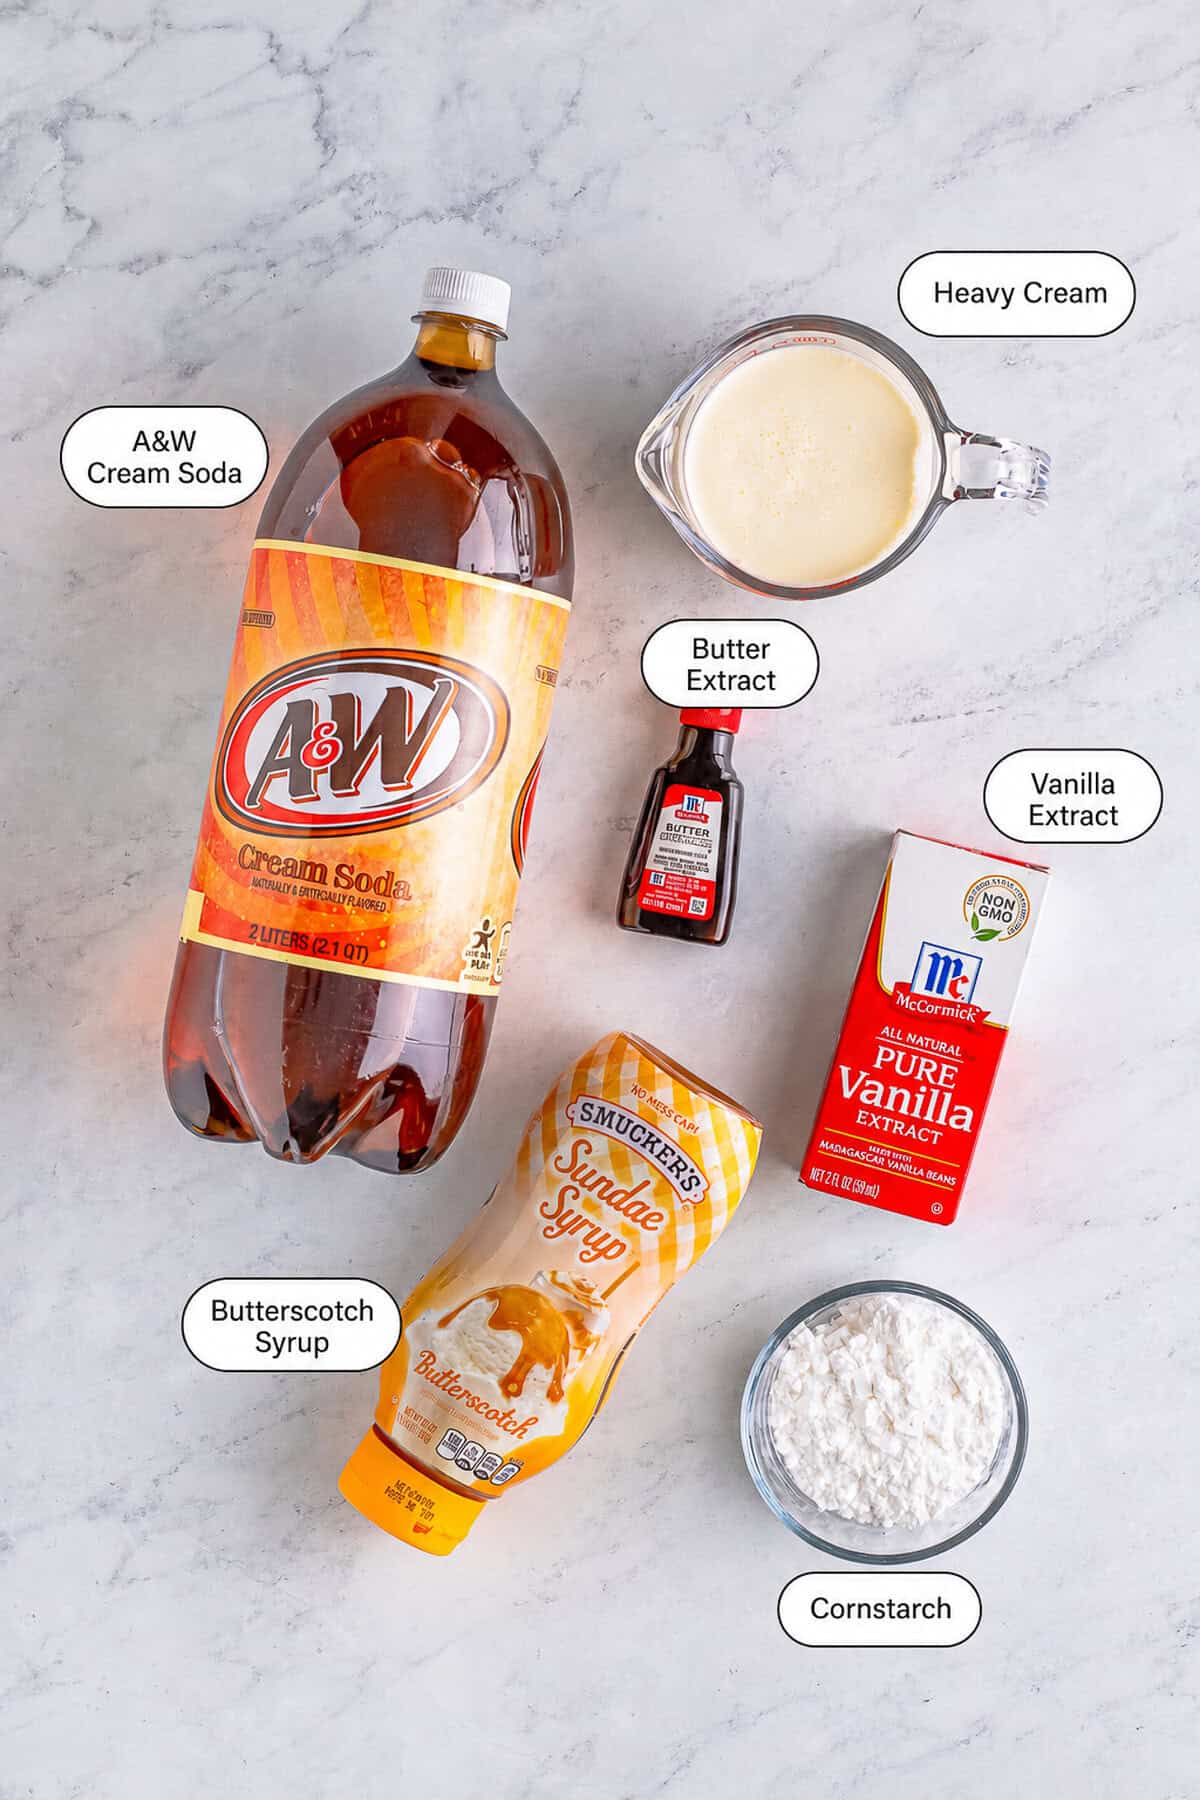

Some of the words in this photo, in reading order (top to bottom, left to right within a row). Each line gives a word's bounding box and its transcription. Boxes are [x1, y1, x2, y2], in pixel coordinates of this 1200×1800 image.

[246, 677, 459, 811] A&W
[665, 823, 710, 838] BUTTER
[237, 843, 328, 886] Cream
[333, 862, 412, 901] Soda
[346, 894, 387, 913] FLAVORED
[978, 905, 1013, 923] GMO
[982, 891, 1016, 912] NON
[248, 923, 258, 940] 2
[259, 925, 309, 951] LITERS
[343, 943, 369, 964] QT)
[895, 990, 977, 1023] McCormick
[880, 1025, 904, 1041] ALL
[905, 1032, 963, 1058] NATURAL
[872, 1044, 959, 1089] PURE
[646, 1096, 674, 1118] MESS
[838, 1064, 975, 1133] Vanilla
[580, 1101, 702, 1192] SMUCKER'S
[855, 1109, 944, 1146] EXTRACT
[809, 1166, 826, 1183] NET
[824, 1170, 833, 1185] 2
[841, 1175, 853, 1191] OZ
[819, 1140, 885, 1166] MADAGASCAR
[887, 1159, 925, 1177] VANILLA
[926, 1169, 957, 1187] BEANS
[554, 1138, 665, 1232] Sundae
[539, 1184, 628, 1264] Syrup
[414, 1350, 540, 1440] Butterscotch
